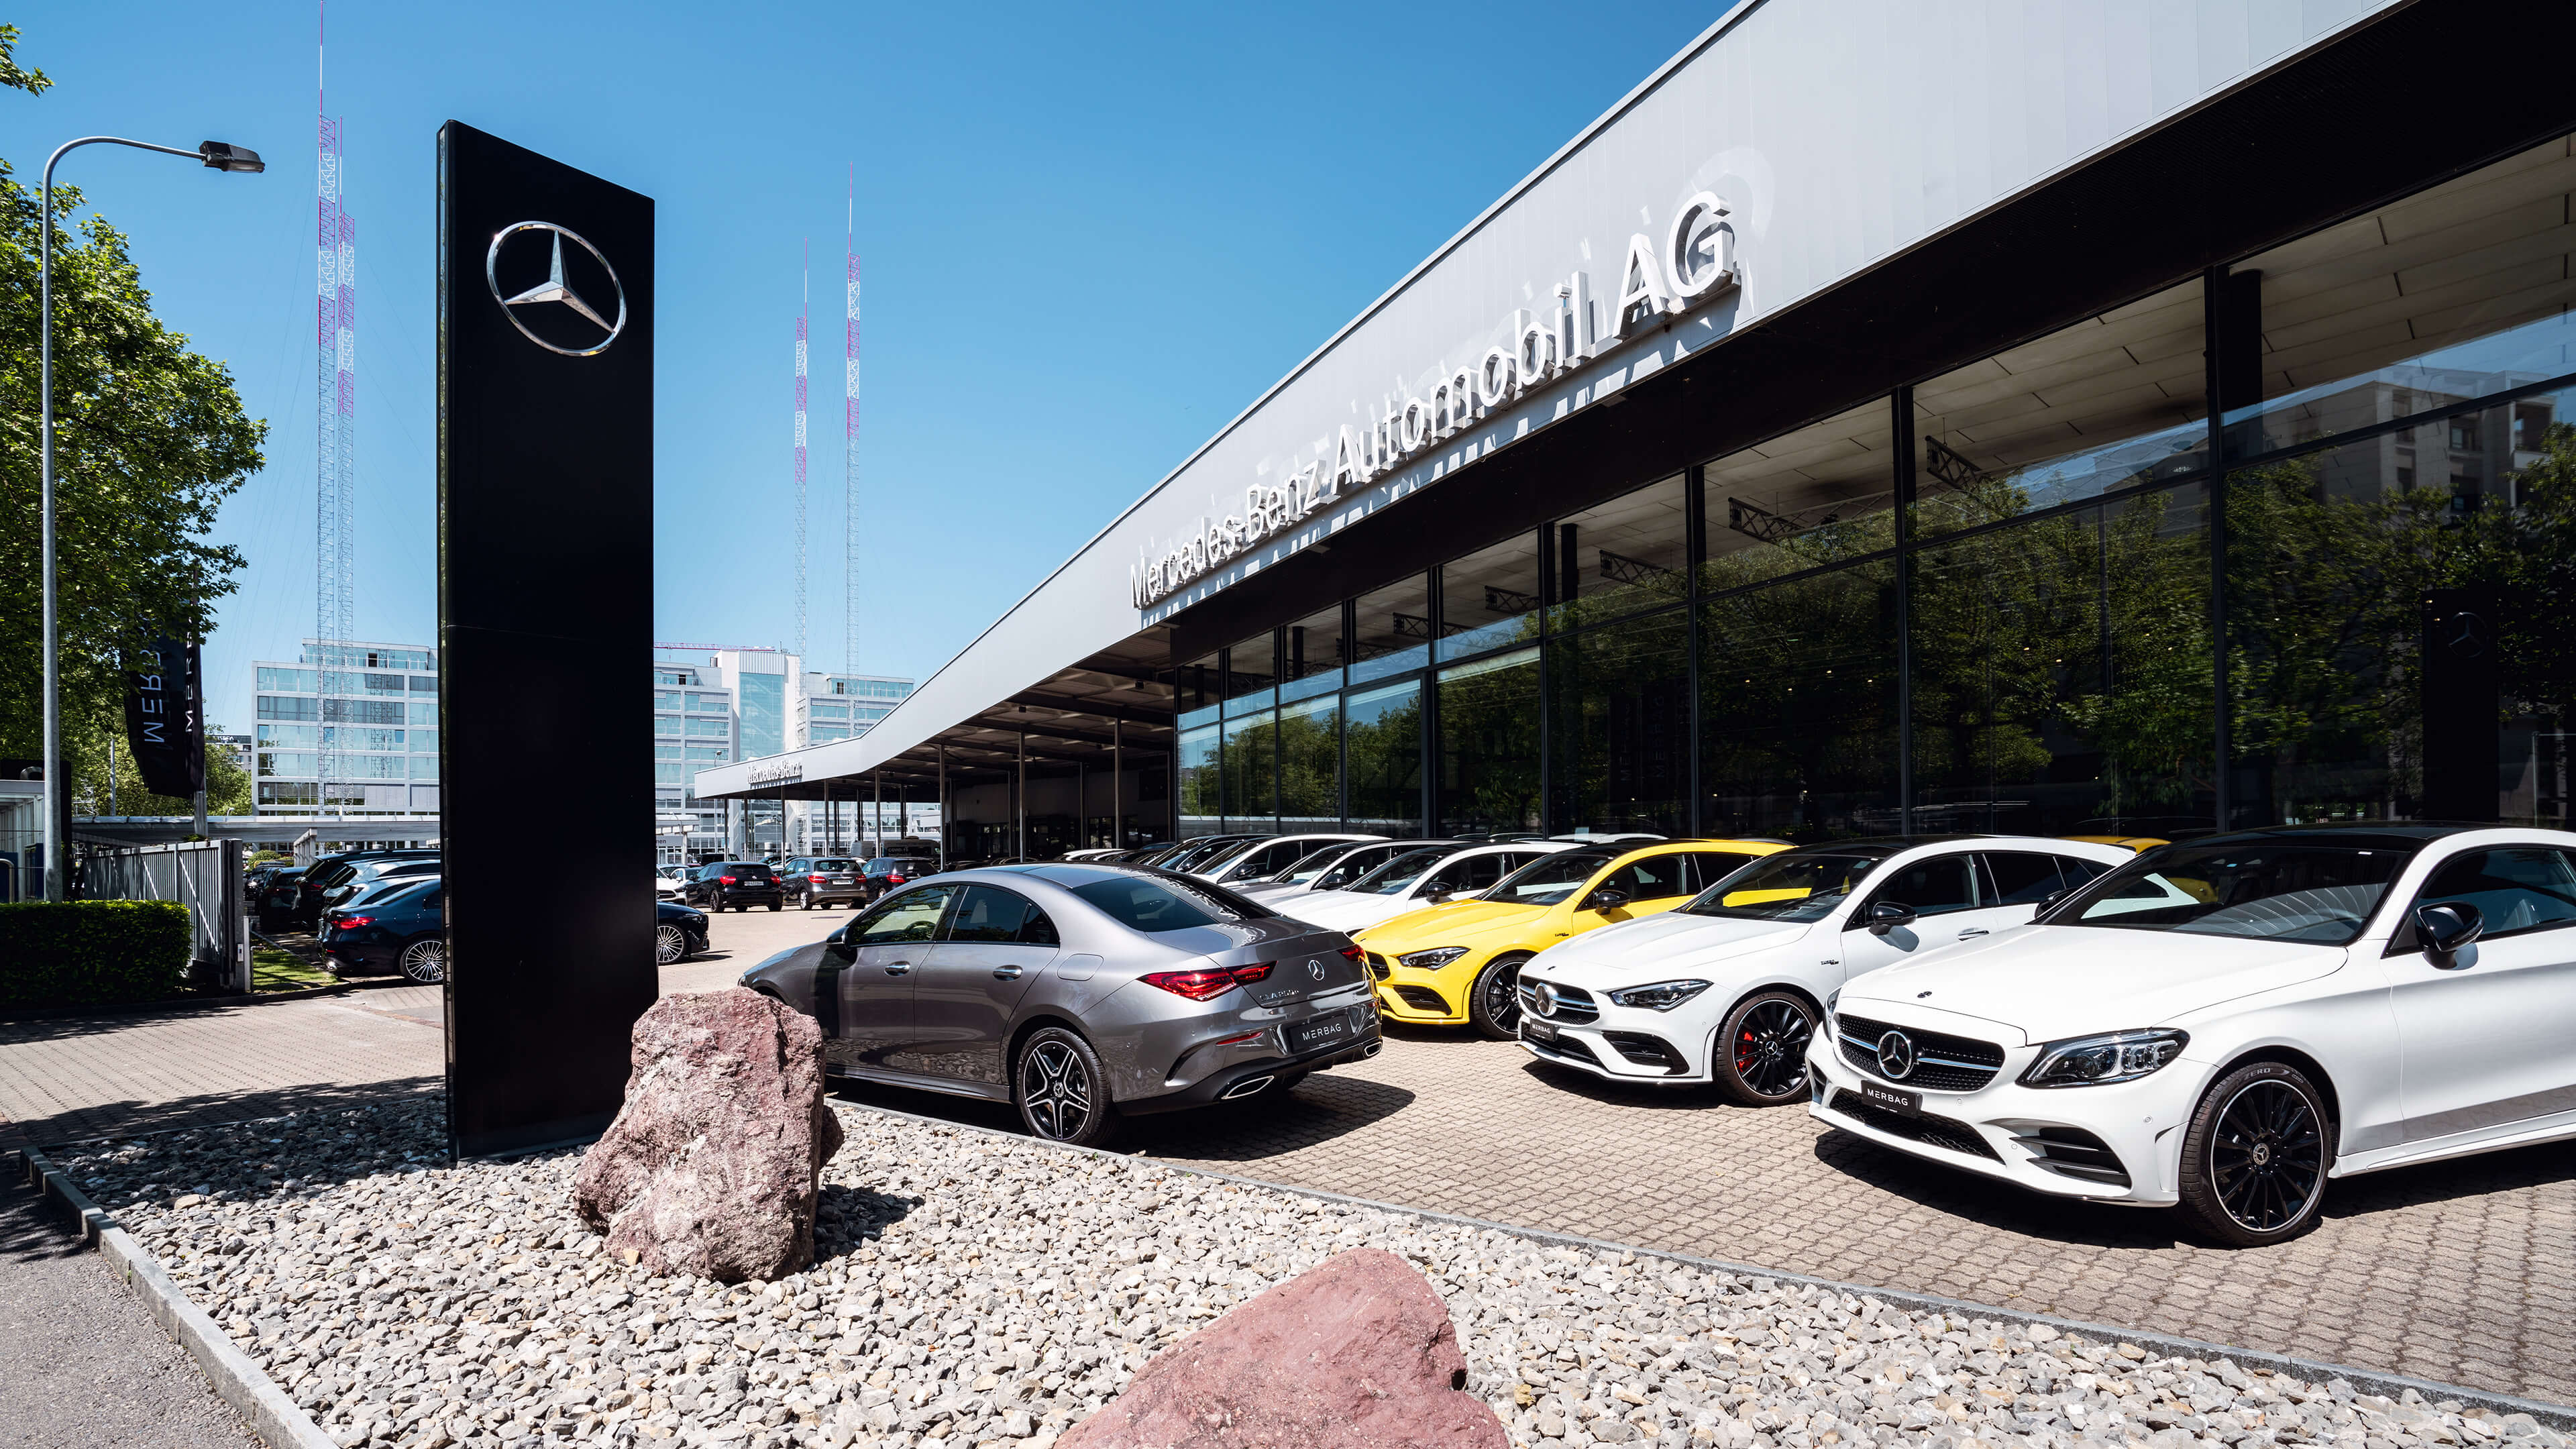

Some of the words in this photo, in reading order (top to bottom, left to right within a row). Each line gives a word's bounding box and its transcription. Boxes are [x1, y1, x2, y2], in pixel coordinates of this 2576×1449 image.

[1130, 459, 1326, 609] Mercedes-Benz
[1331, 270, 1589, 496] Automobil
[1612, 191, 1736, 340] AG
[747, 761, 801, 784] Mercedes-Benz
[1302, 1023, 1342, 1041] MERBAG
[1532, 1023, 1551, 1034] MERBAG
[2244, 1067, 2271, 1080] ZERO
[1867, 1088, 1908, 1106] MERBAG
